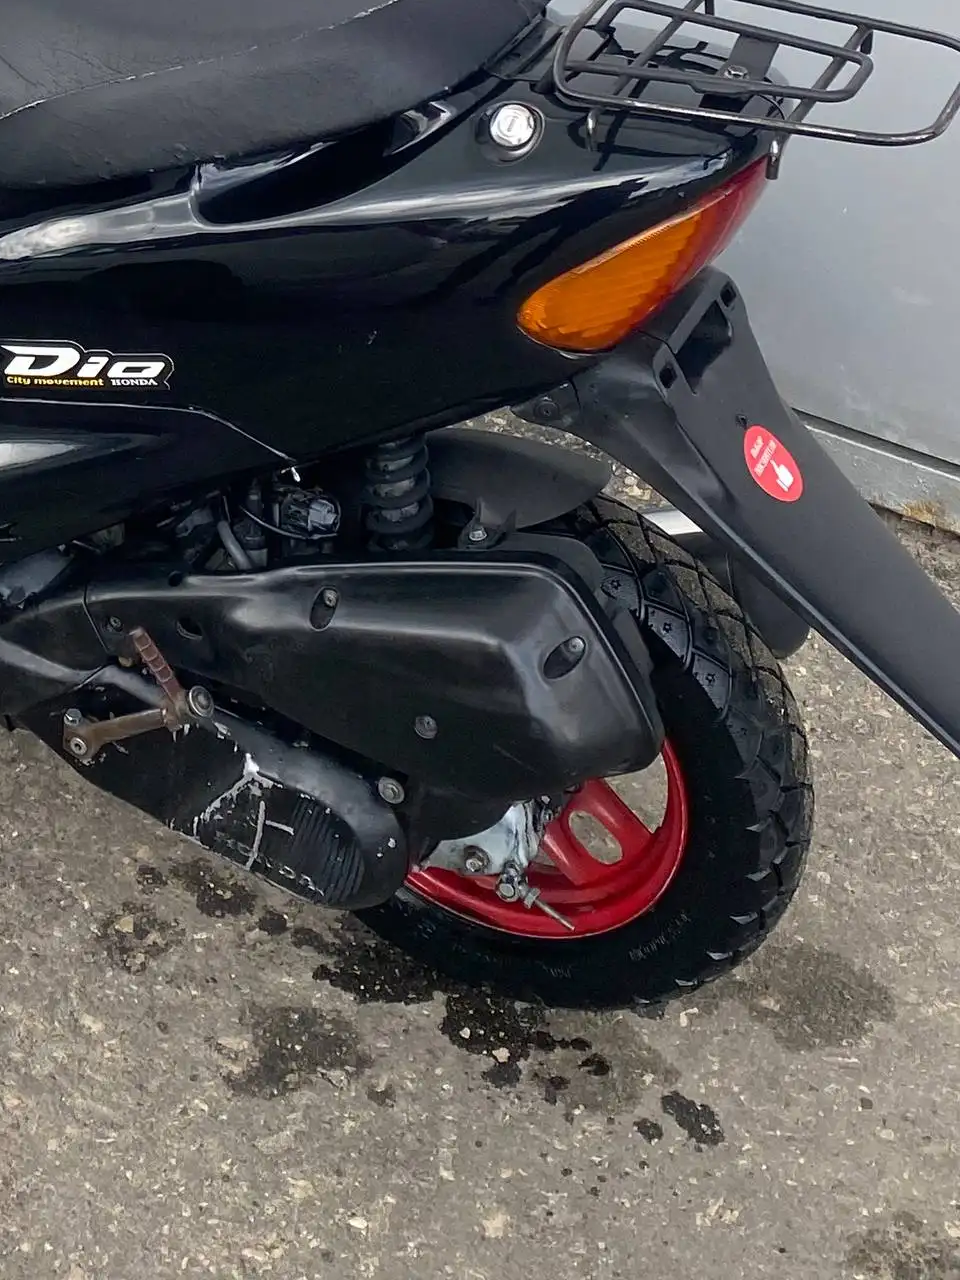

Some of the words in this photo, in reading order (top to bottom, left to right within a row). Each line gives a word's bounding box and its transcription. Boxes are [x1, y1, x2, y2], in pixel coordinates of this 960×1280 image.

[0, 345, 166, 378] Dio
[34, 378, 105, 387] movement
[110, 378, 159, 386] HONDA
